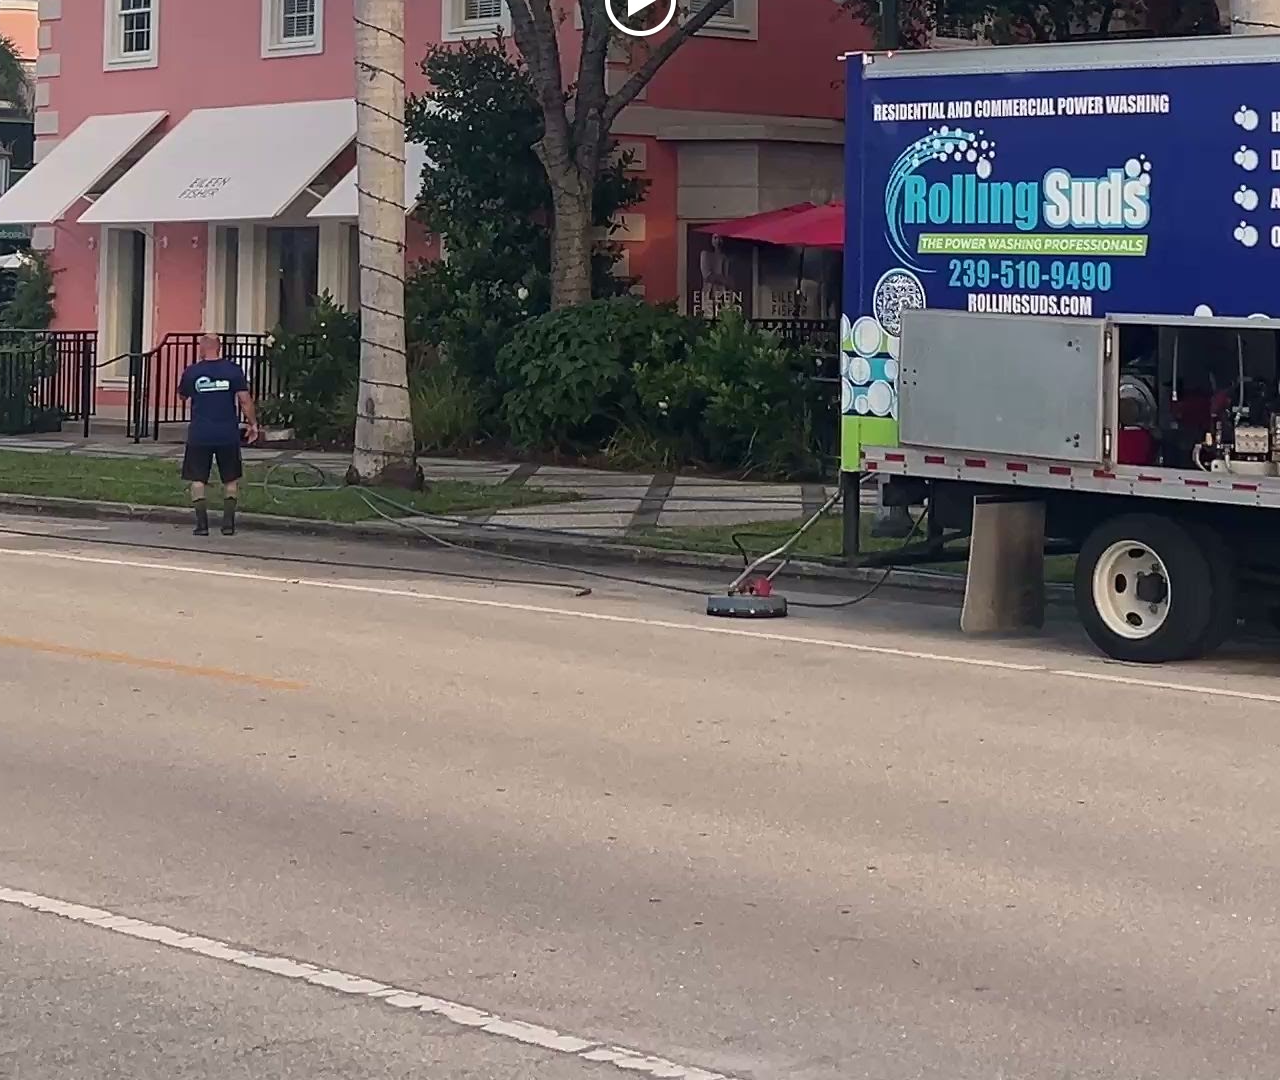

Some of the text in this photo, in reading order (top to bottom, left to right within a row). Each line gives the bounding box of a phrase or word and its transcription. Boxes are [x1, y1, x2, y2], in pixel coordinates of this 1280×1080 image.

[873, 94, 1170, 121] RESIDENTIAL AND COMMERCIAL POWER WASHING
[904, 168, 1150, 231] Rolling Suds
[921, 238, 1143, 252] THE POWER WASHING PROFESSIONALS
[949, 259, 1111, 291] 239-510-9490
[968, 294, 1093, 316] ROLLINGSUDS.COM
